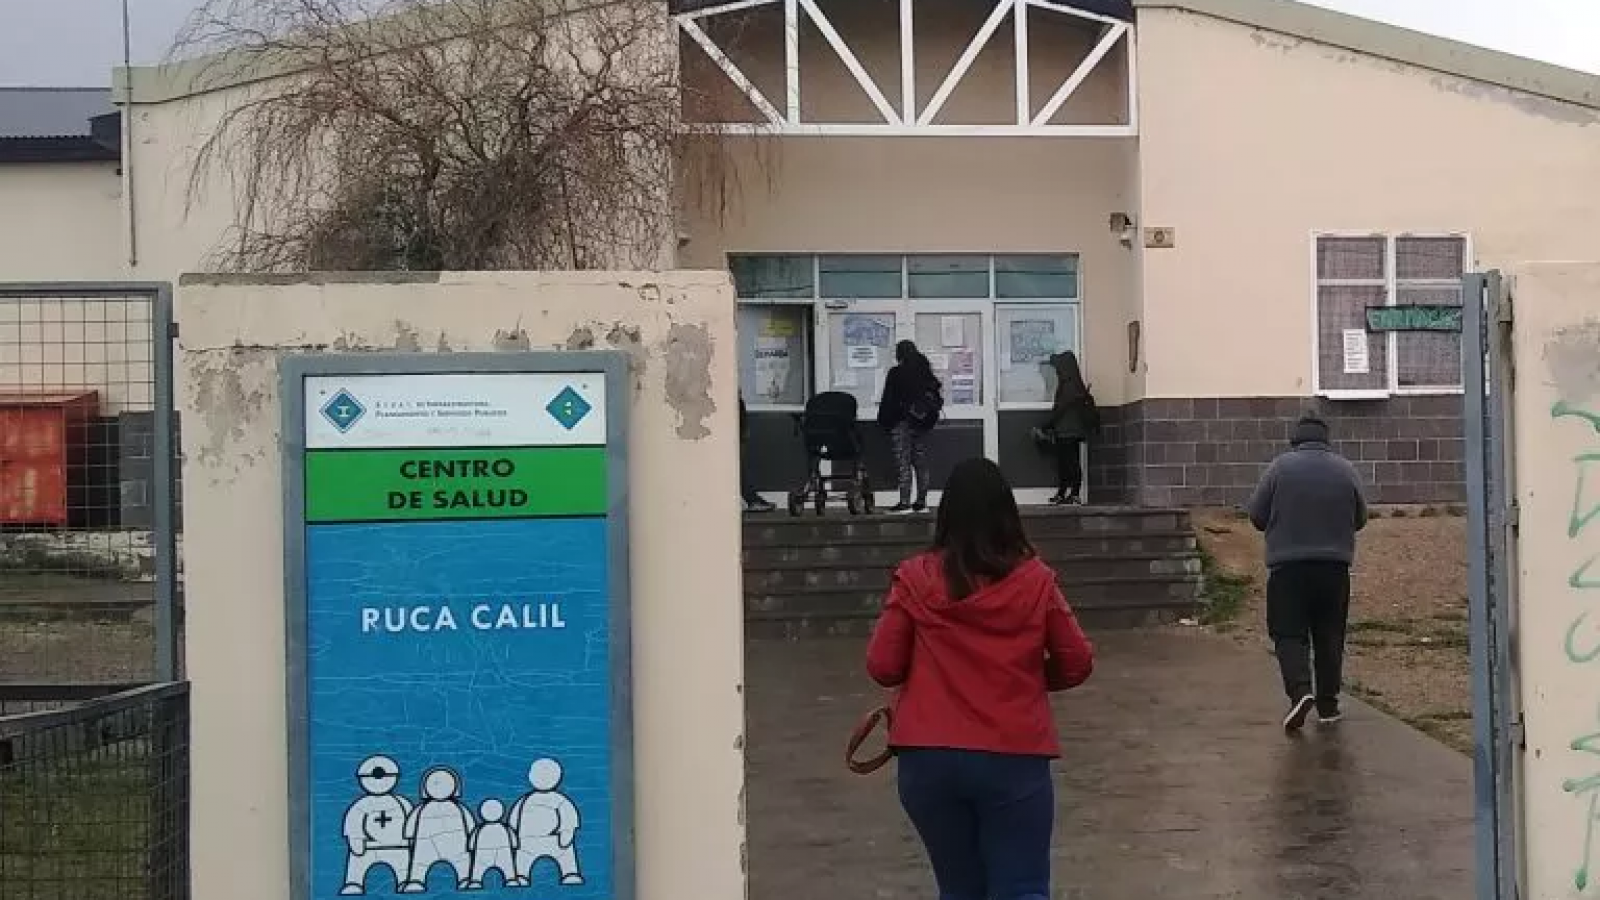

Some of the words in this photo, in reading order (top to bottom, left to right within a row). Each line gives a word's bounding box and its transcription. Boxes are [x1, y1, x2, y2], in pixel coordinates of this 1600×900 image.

[400, 458, 515, 479] CENTRO
[387, 491, 422, 509] DE
[433, 489, 528, 509] SALUD
[361, 605, 458, 632] RUCA
[471, 603, 566, 630] CALIL
